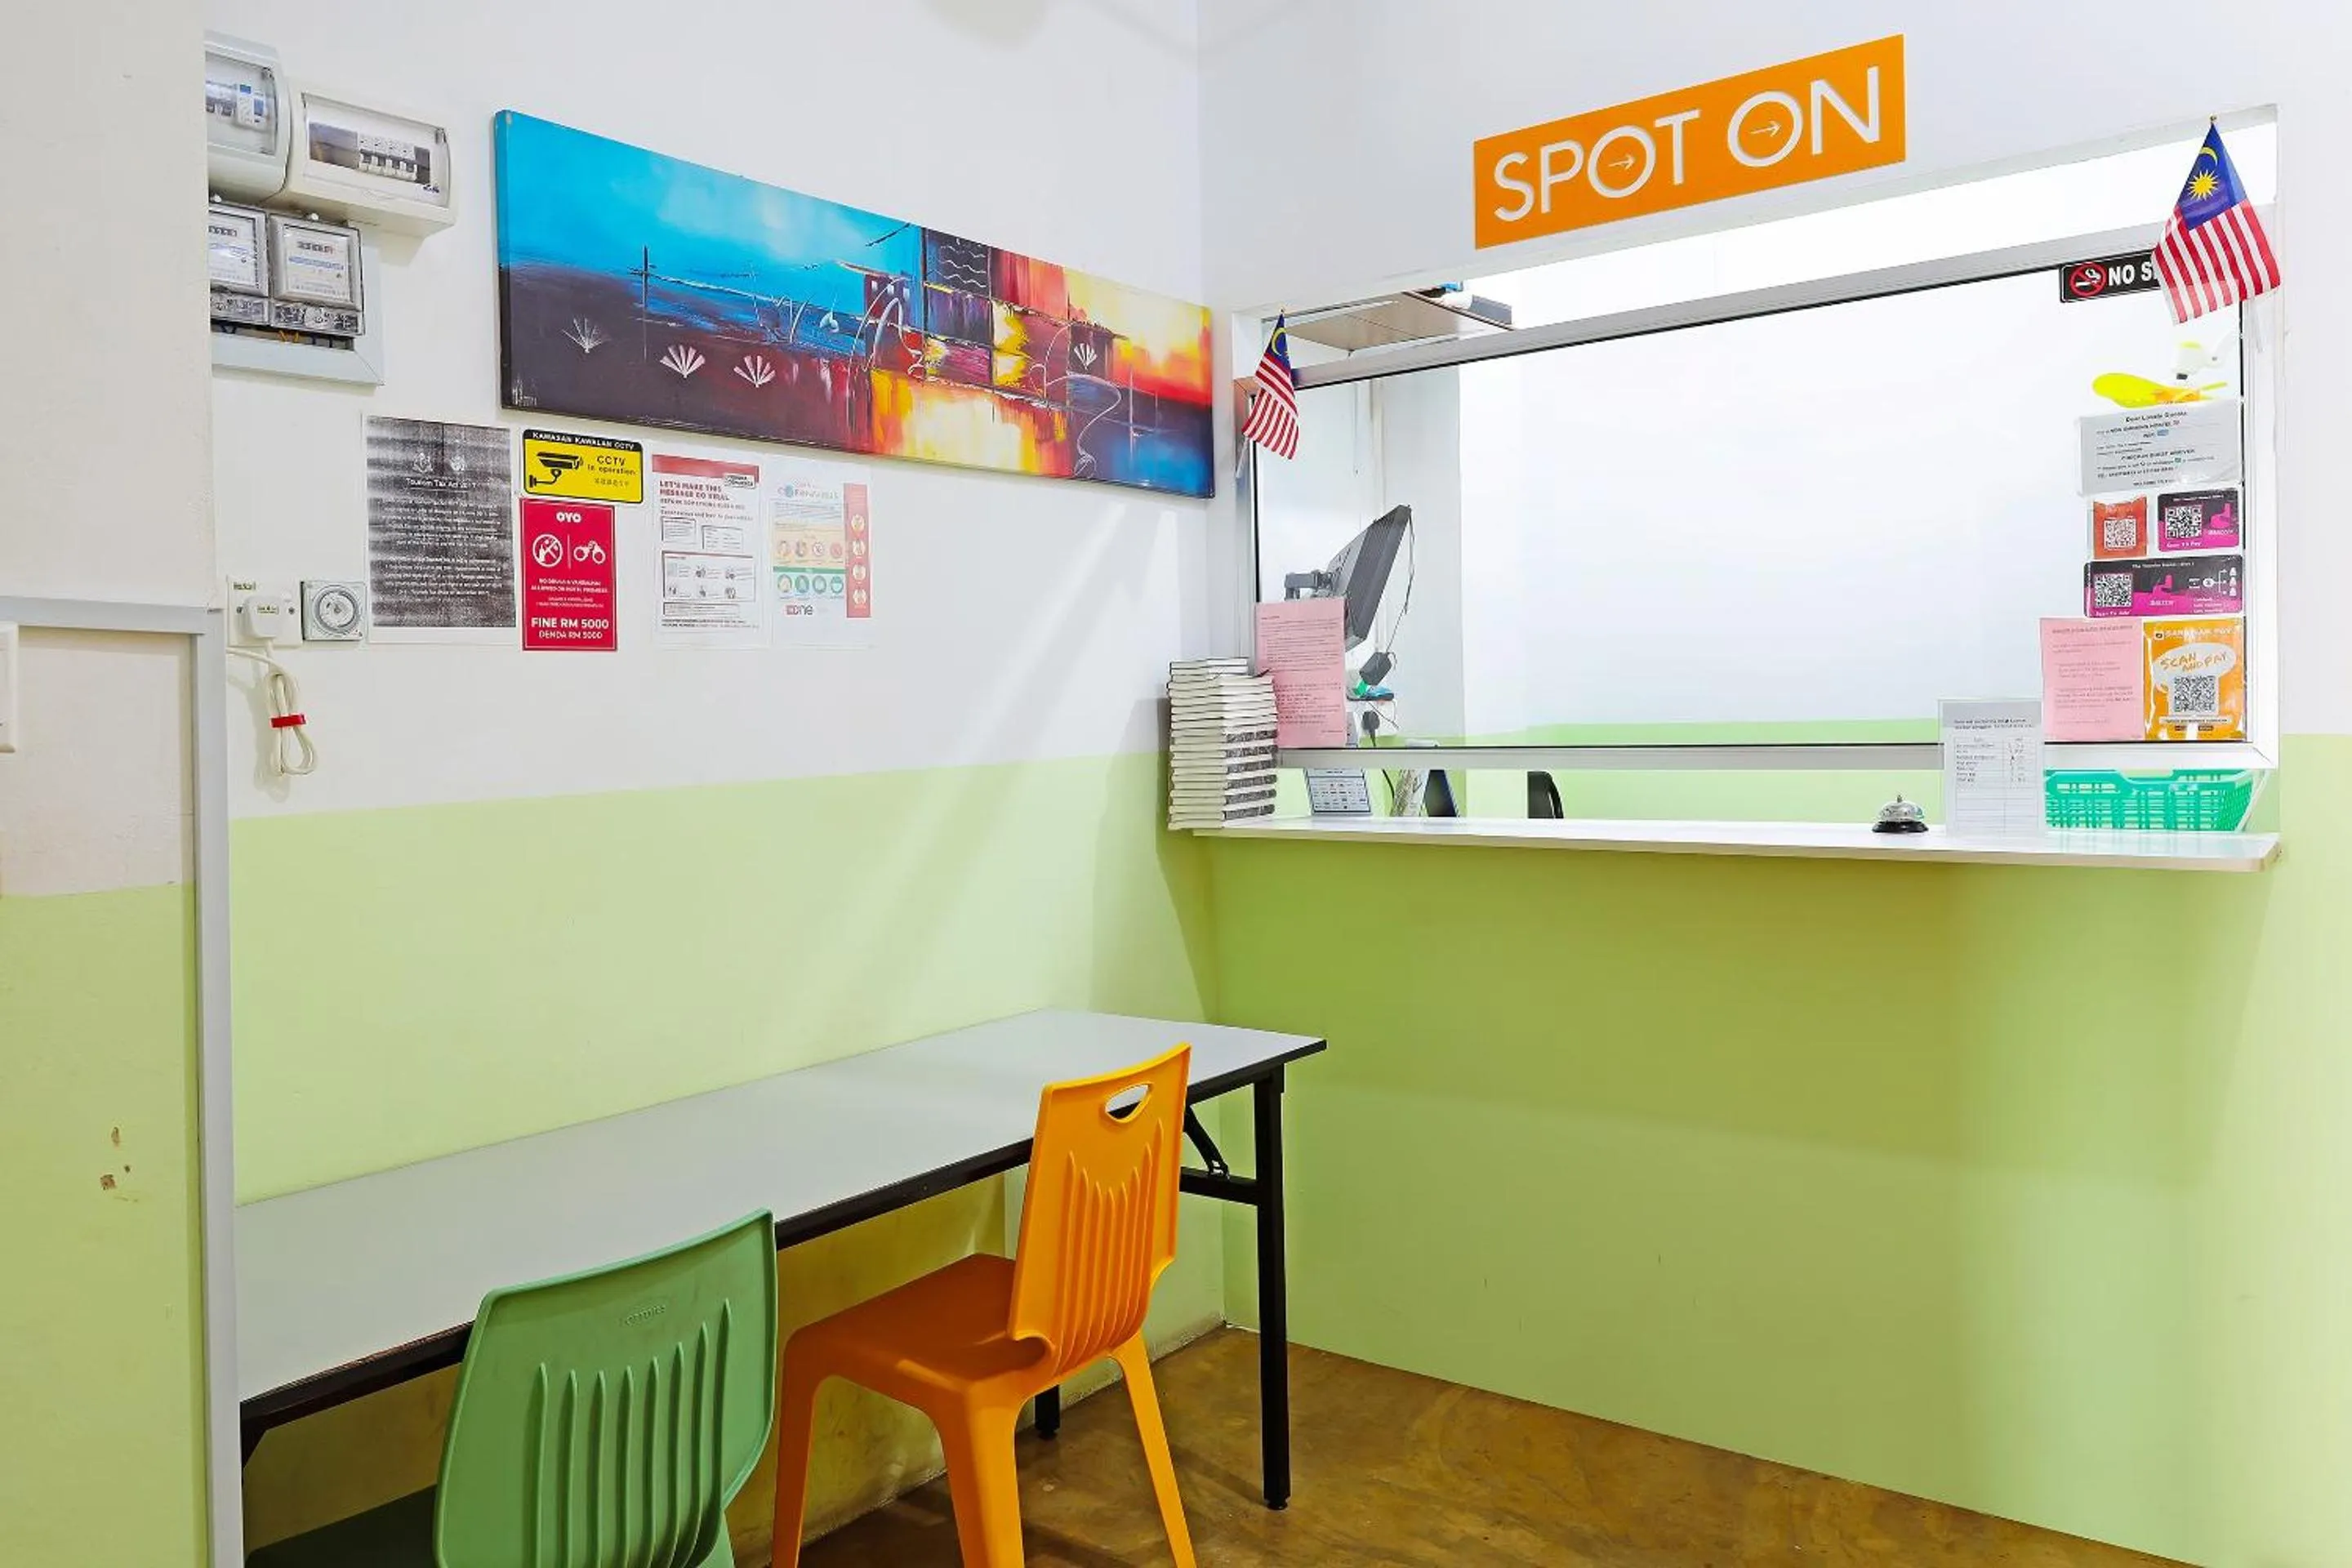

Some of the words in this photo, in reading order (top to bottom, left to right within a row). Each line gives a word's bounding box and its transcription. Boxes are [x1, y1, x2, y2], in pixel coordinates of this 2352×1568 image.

[1493, 109, 1702, 222] SPOT
[1727, 66, 1881, 167] ON
[2108, 265, 2135, 286] NO
[596, 456, 626, 466] CCTV
[555, 511, 581, 523] OYO
[531, 617, 557, 628] FINE
[560, 617, 578, 628] RM
[581, 618, 609, 629] 5000
[539, 630, 567, 639] DENDA
[2160, 652, 2197, 670] SCAN
[2204, 651, 2227, 667] PAY
